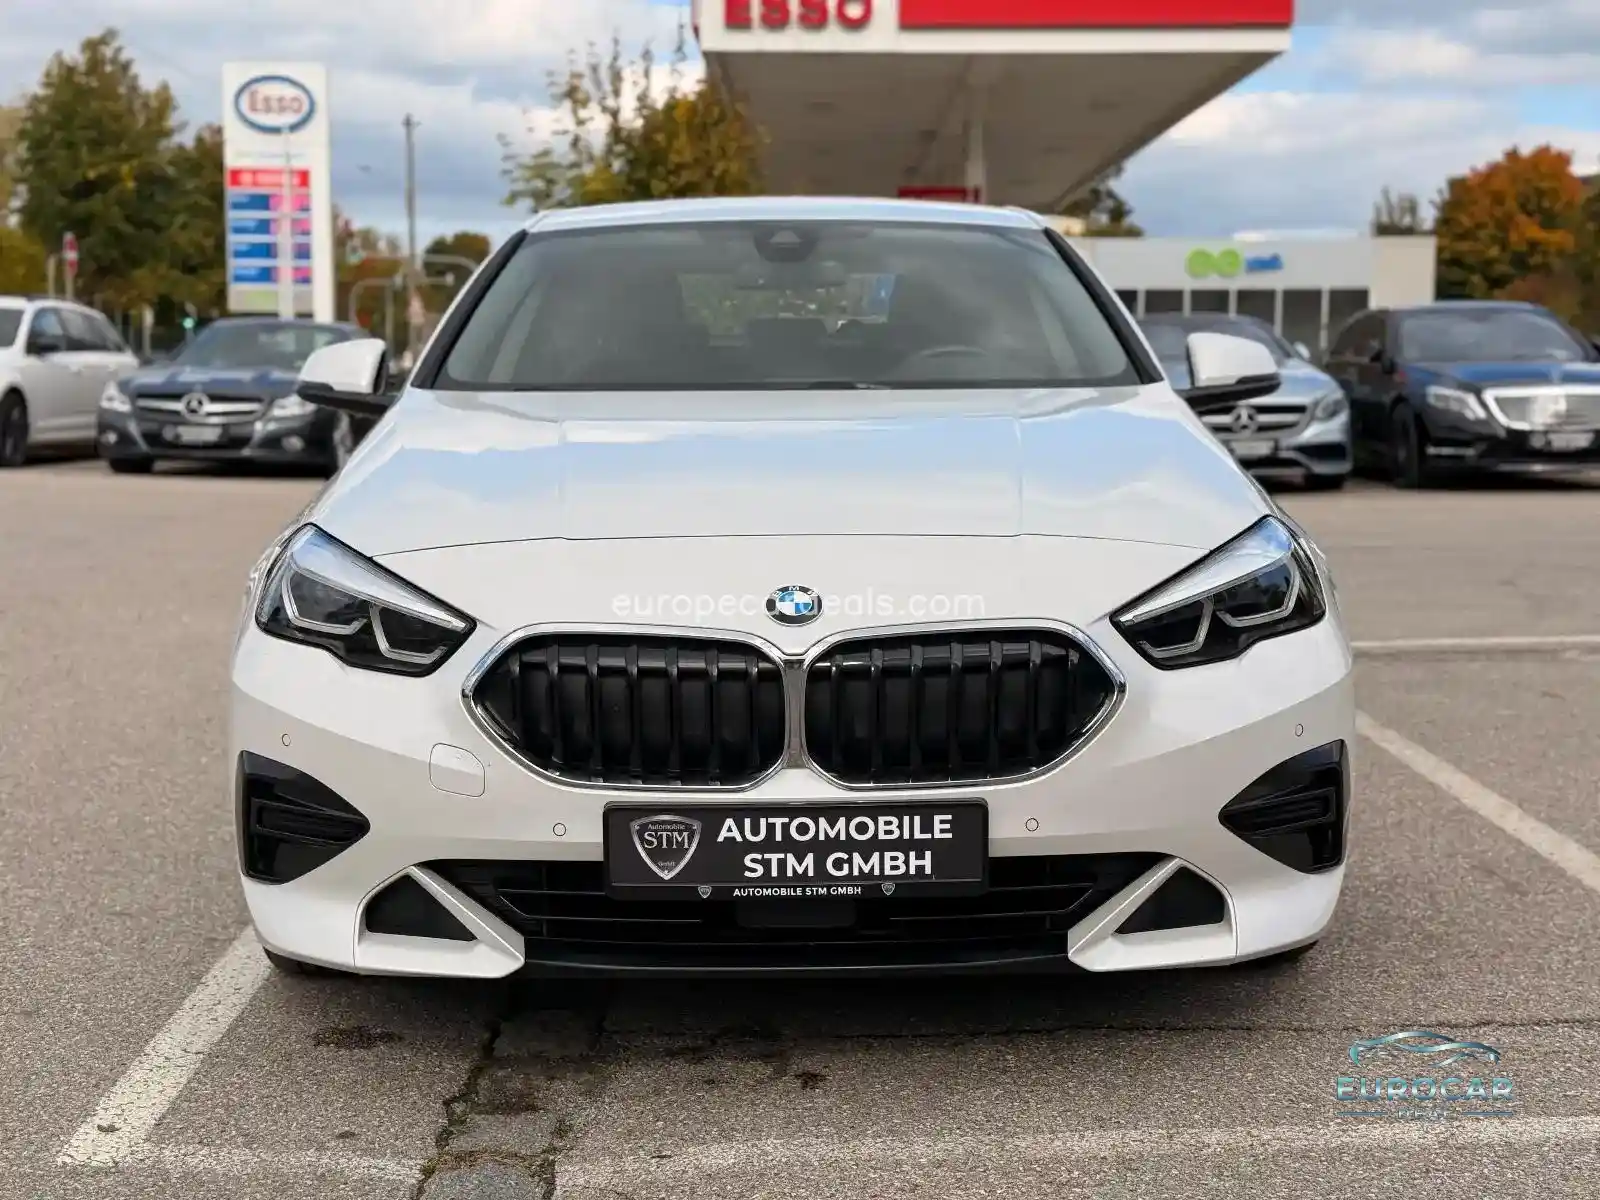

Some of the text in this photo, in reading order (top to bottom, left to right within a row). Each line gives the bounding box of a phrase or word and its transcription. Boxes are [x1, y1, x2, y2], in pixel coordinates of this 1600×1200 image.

[247, 88, 305, 115] Esso
[643, 831, 690, 849] STM
[716, 814, 953, 842] AUTOMOBILE
[743, 850, 932, 878] STM GMBH
[733, 886, 862, 897] AUTOMOBILE STM GMBH
